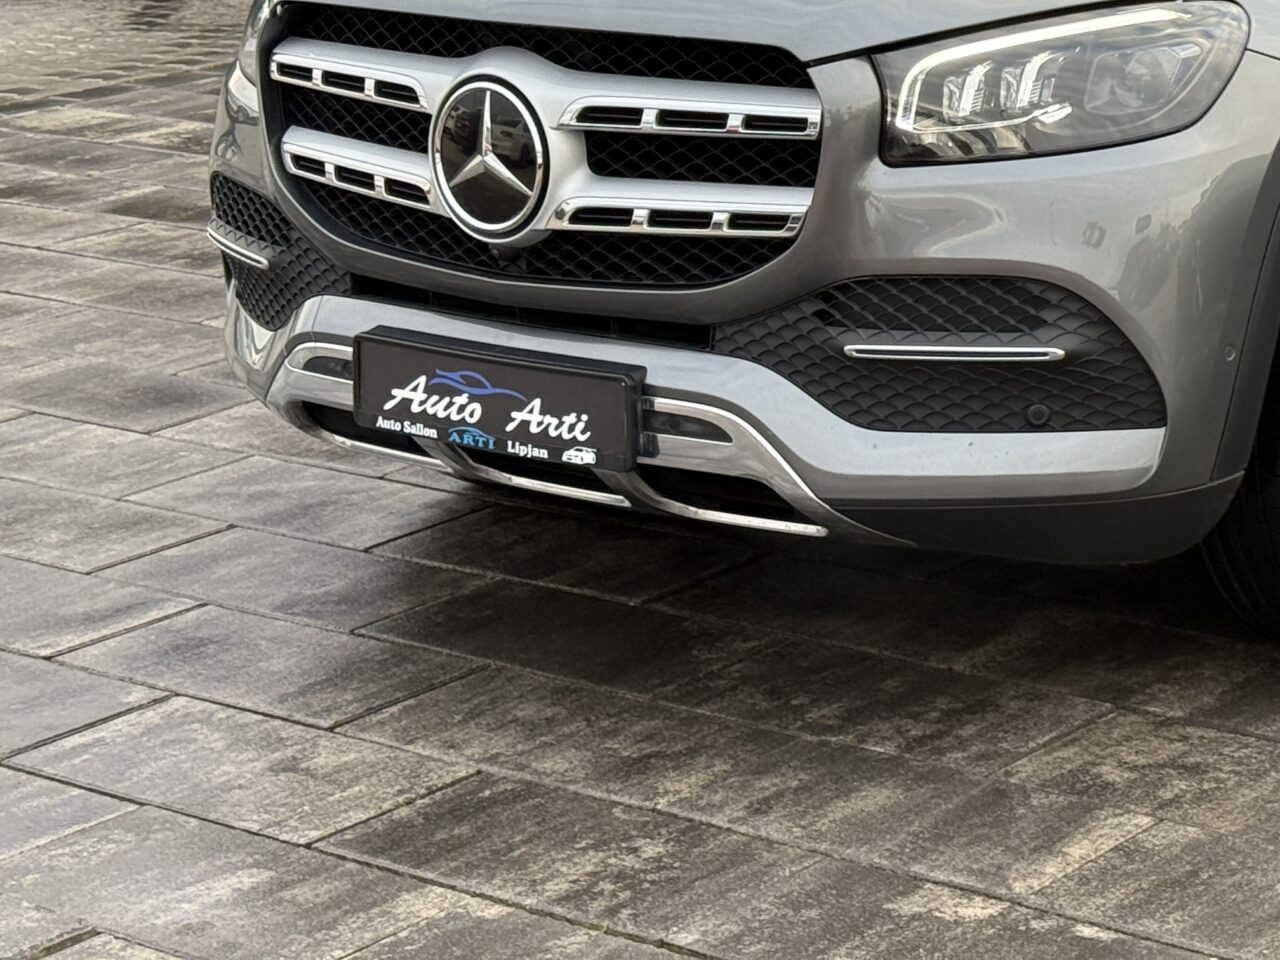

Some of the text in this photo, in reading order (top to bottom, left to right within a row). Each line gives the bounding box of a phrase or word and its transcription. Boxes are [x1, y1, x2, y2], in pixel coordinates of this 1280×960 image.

[383, 374, 591, 441] Auto Arti
[375, 415, 439, 439] Auto Sallon
[447, 431, 496, 450] ARTI
[506, 440, 549, 459] Lipjan
